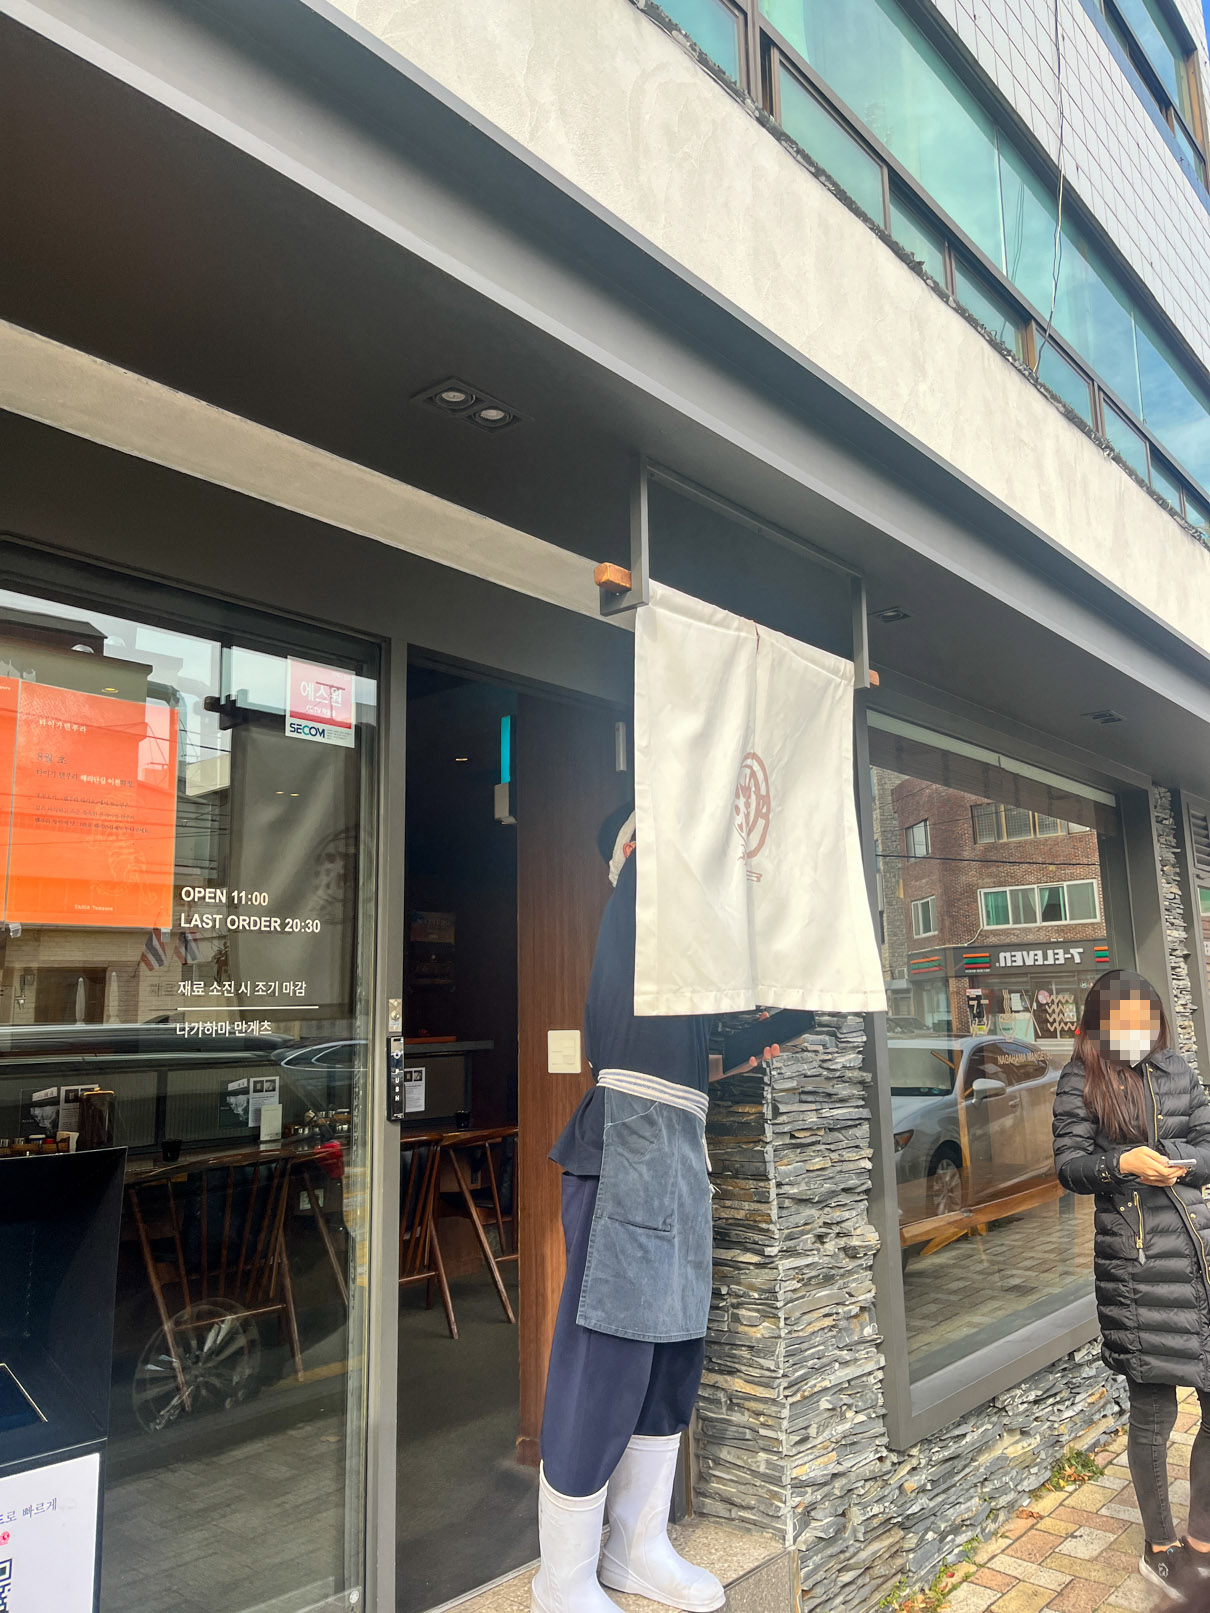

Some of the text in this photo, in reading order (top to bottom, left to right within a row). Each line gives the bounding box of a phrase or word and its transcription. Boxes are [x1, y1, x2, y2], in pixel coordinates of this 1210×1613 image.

[300, 680, 342, 707] 에스원
[289, 722, 326, 738] SECOM
[181, 886, 269, 906] OPEN 11:00
[180, 913, 321, 933] LAST ORDER 20:30
[177, 981, 307, 997] 재료 소진 시 조기 마감
[176, 1020, 272, 1038] 나가하마 만게츠
[22, 1497, 57, 1518] 빠르게
